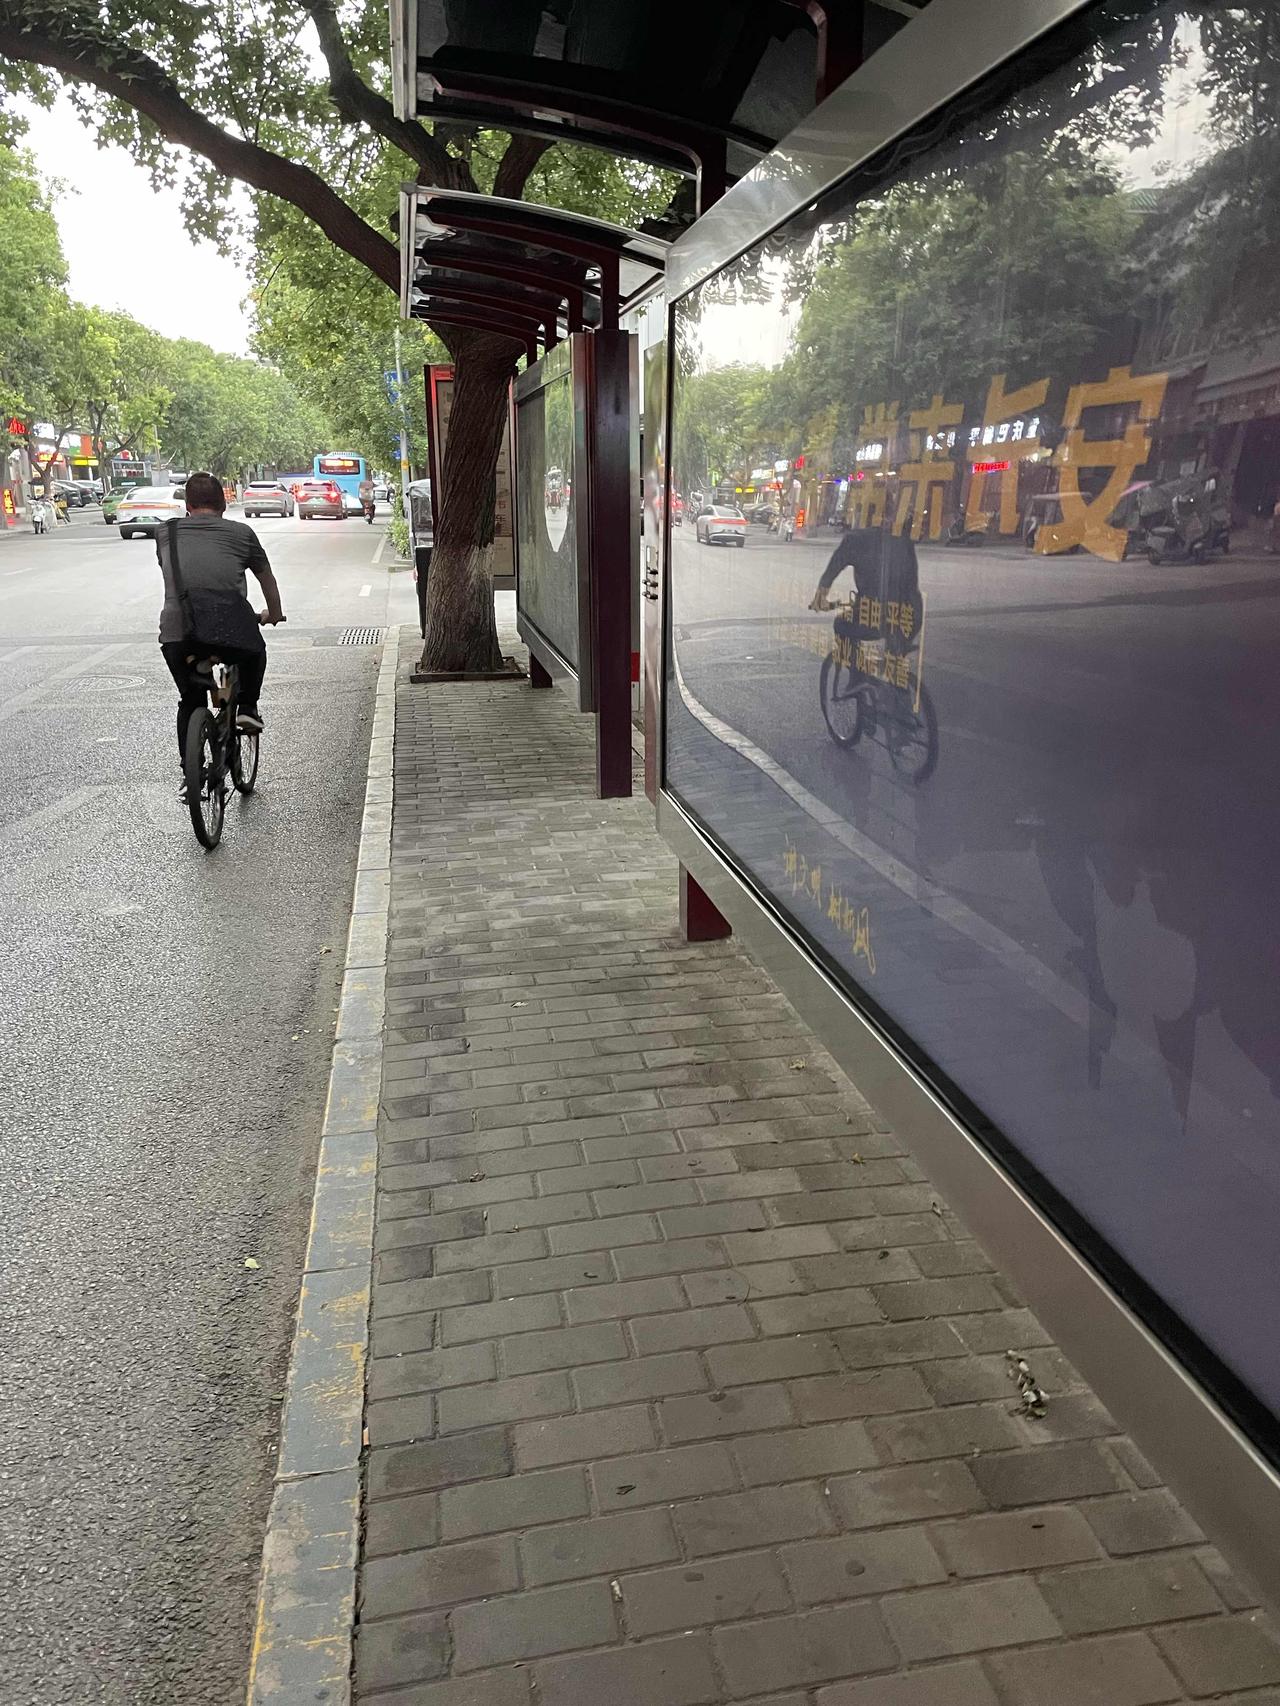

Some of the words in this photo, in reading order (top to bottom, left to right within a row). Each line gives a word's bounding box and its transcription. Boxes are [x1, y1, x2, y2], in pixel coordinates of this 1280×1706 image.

[859, 595, 882, 630] 自由
[887, 601, 914, 638] 平等
[884, 651, 911, 689] 友善
